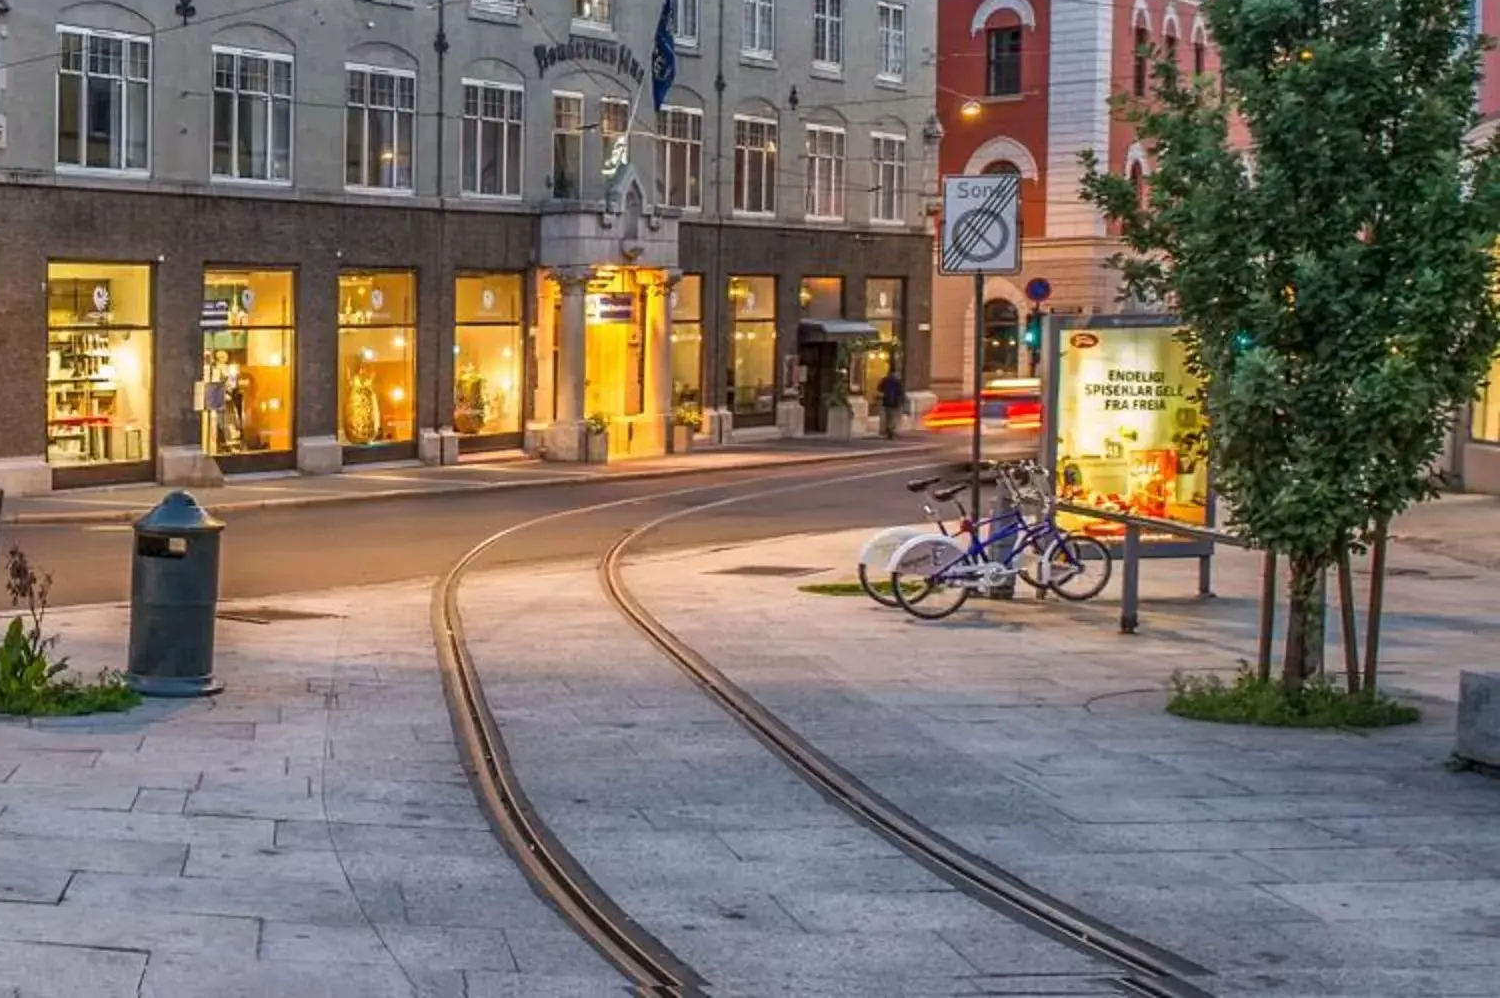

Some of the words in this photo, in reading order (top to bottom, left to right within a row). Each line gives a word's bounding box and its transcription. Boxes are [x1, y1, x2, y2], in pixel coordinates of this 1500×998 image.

[1084, 383, 1154, 397] SPISEKLAR
[1104, 398, 1130, 411] FRA
[1132, 398, 1168, 411] FREIA
